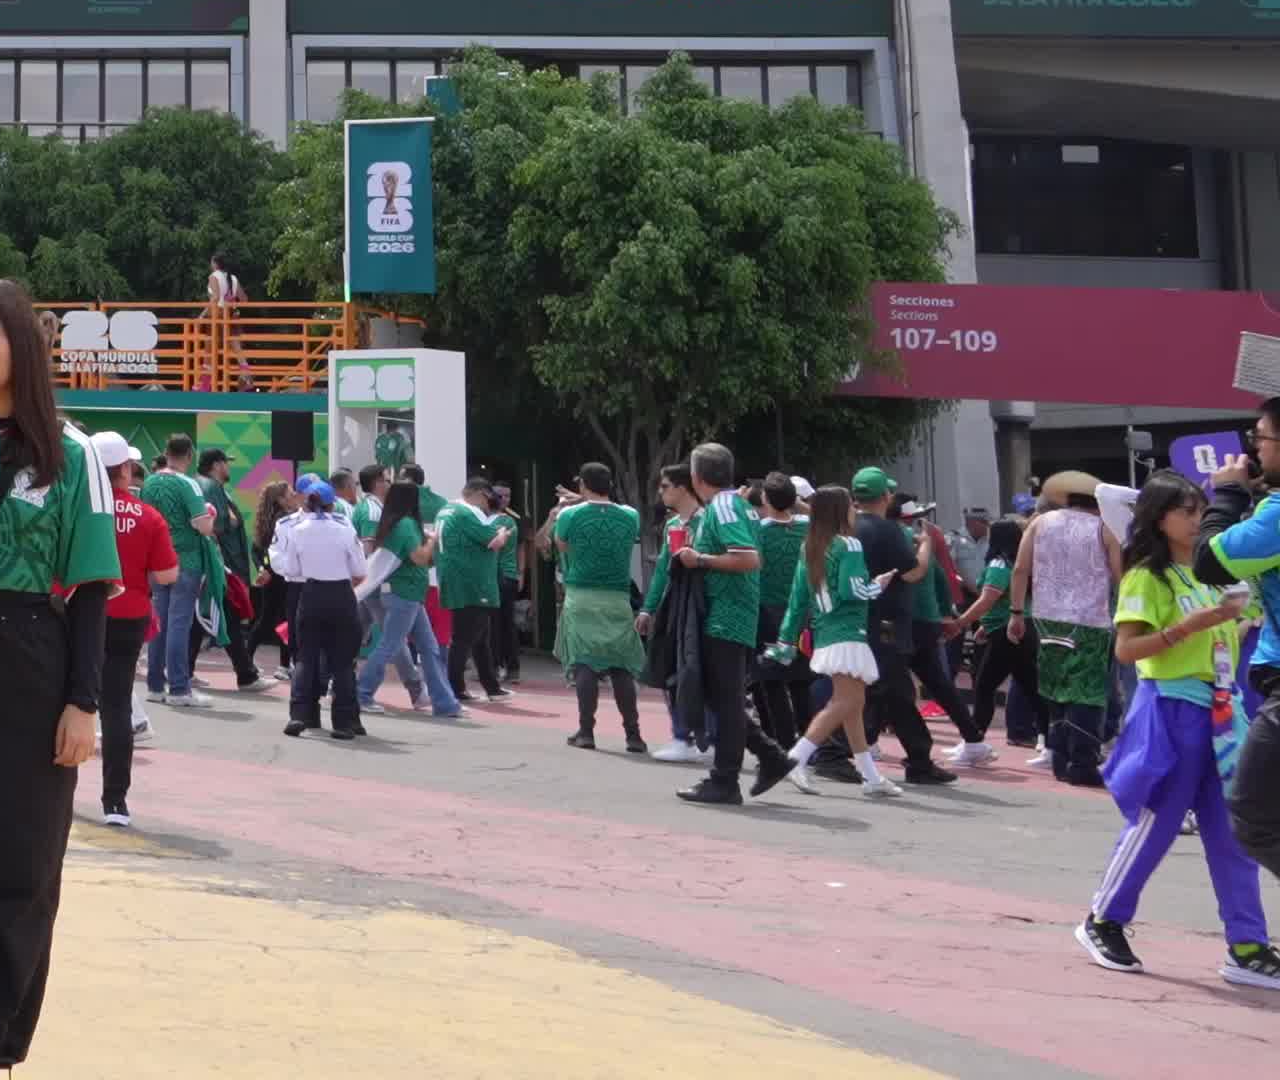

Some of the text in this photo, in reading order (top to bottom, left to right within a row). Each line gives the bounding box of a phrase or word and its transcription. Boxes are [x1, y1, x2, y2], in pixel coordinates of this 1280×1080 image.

[380, 217, 401, 225] FIFA
[367, 242, 415, 253] 2026
[889, 294, 955, 308] Secciones
[889, 309, 939, 321] Sections
[60, 351, 157, 363] COPA MUNDIAL
[60, 362, 158, 373] DE LA FIFA 2026
